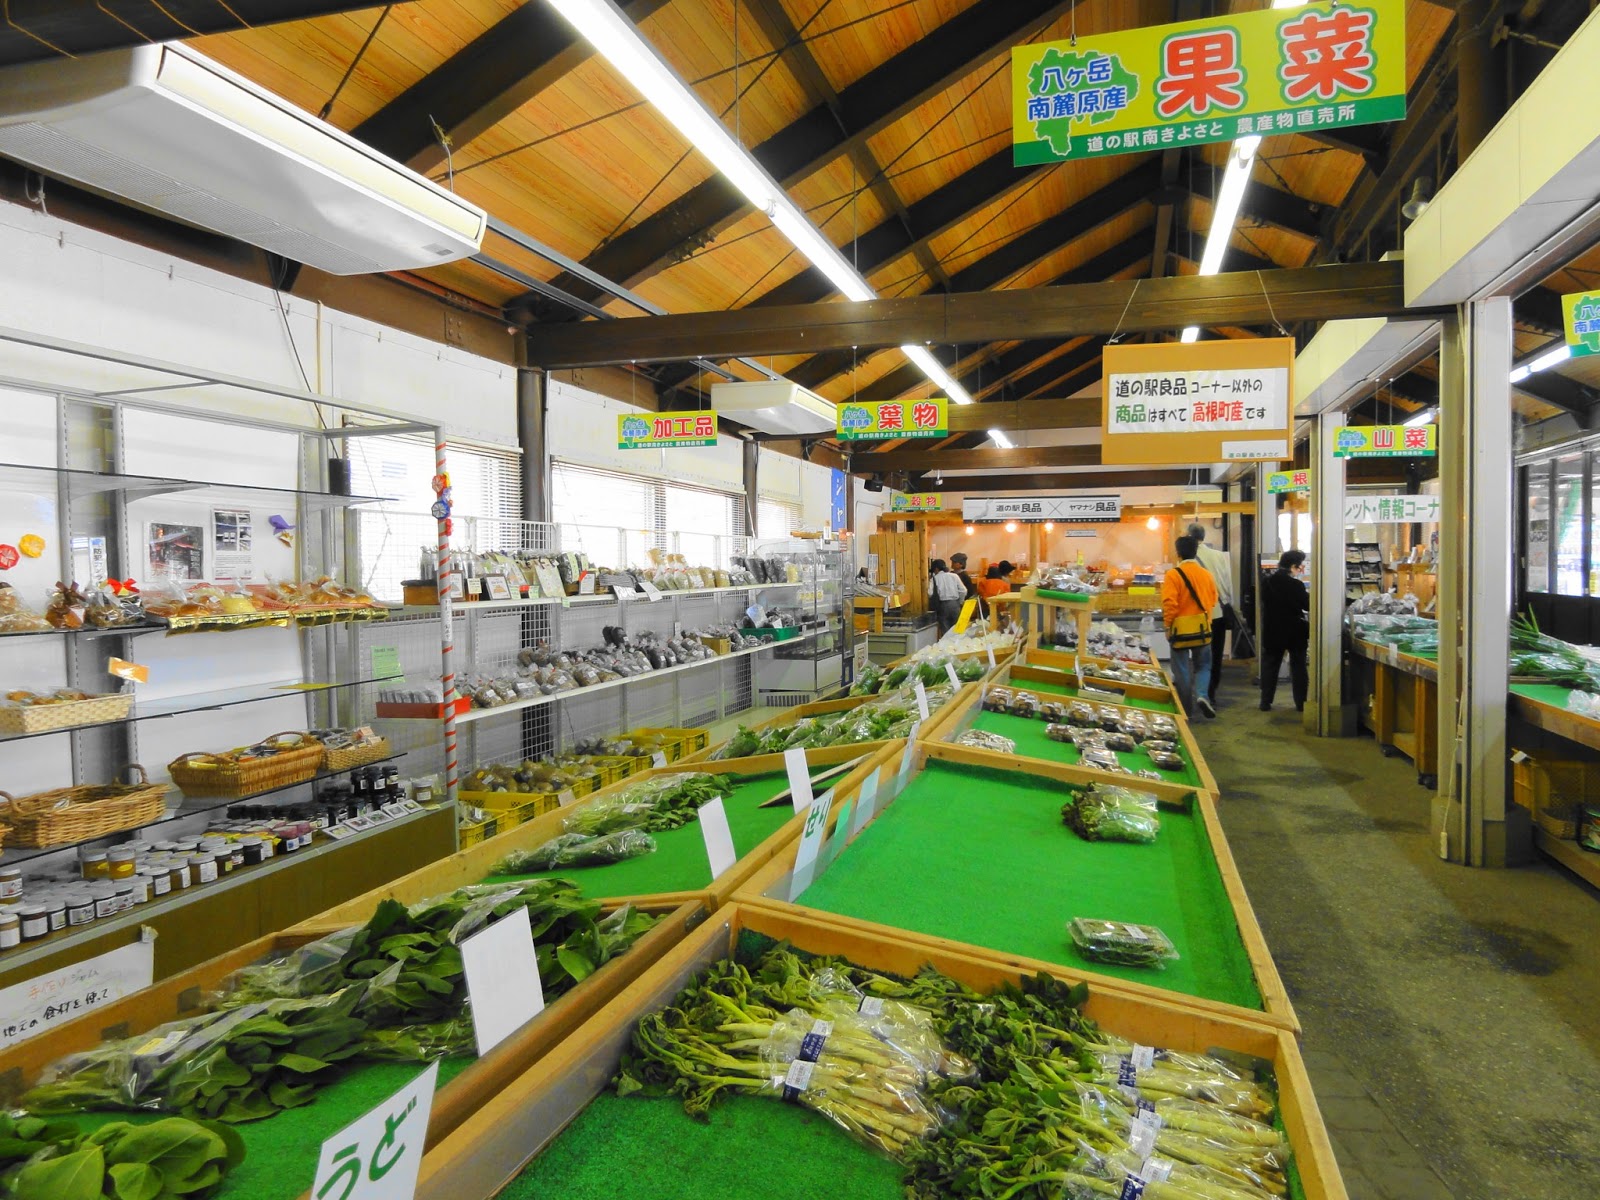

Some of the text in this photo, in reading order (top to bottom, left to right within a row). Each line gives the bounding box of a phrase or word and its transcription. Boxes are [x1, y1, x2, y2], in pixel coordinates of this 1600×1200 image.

[1157, 9, 1372, 116] 果菜
[1027, 86, 1127, 121] 南麓原産
[1087, 104, 1357, 153] 道の駅南きよさと 農産物直売所
[653, 416, 714, 439] 加工品
[878, 403, 938, 430] 葉物
[1373, 428, 1427, 448] 山菜
[316, 1095, 417, 1200] うど
